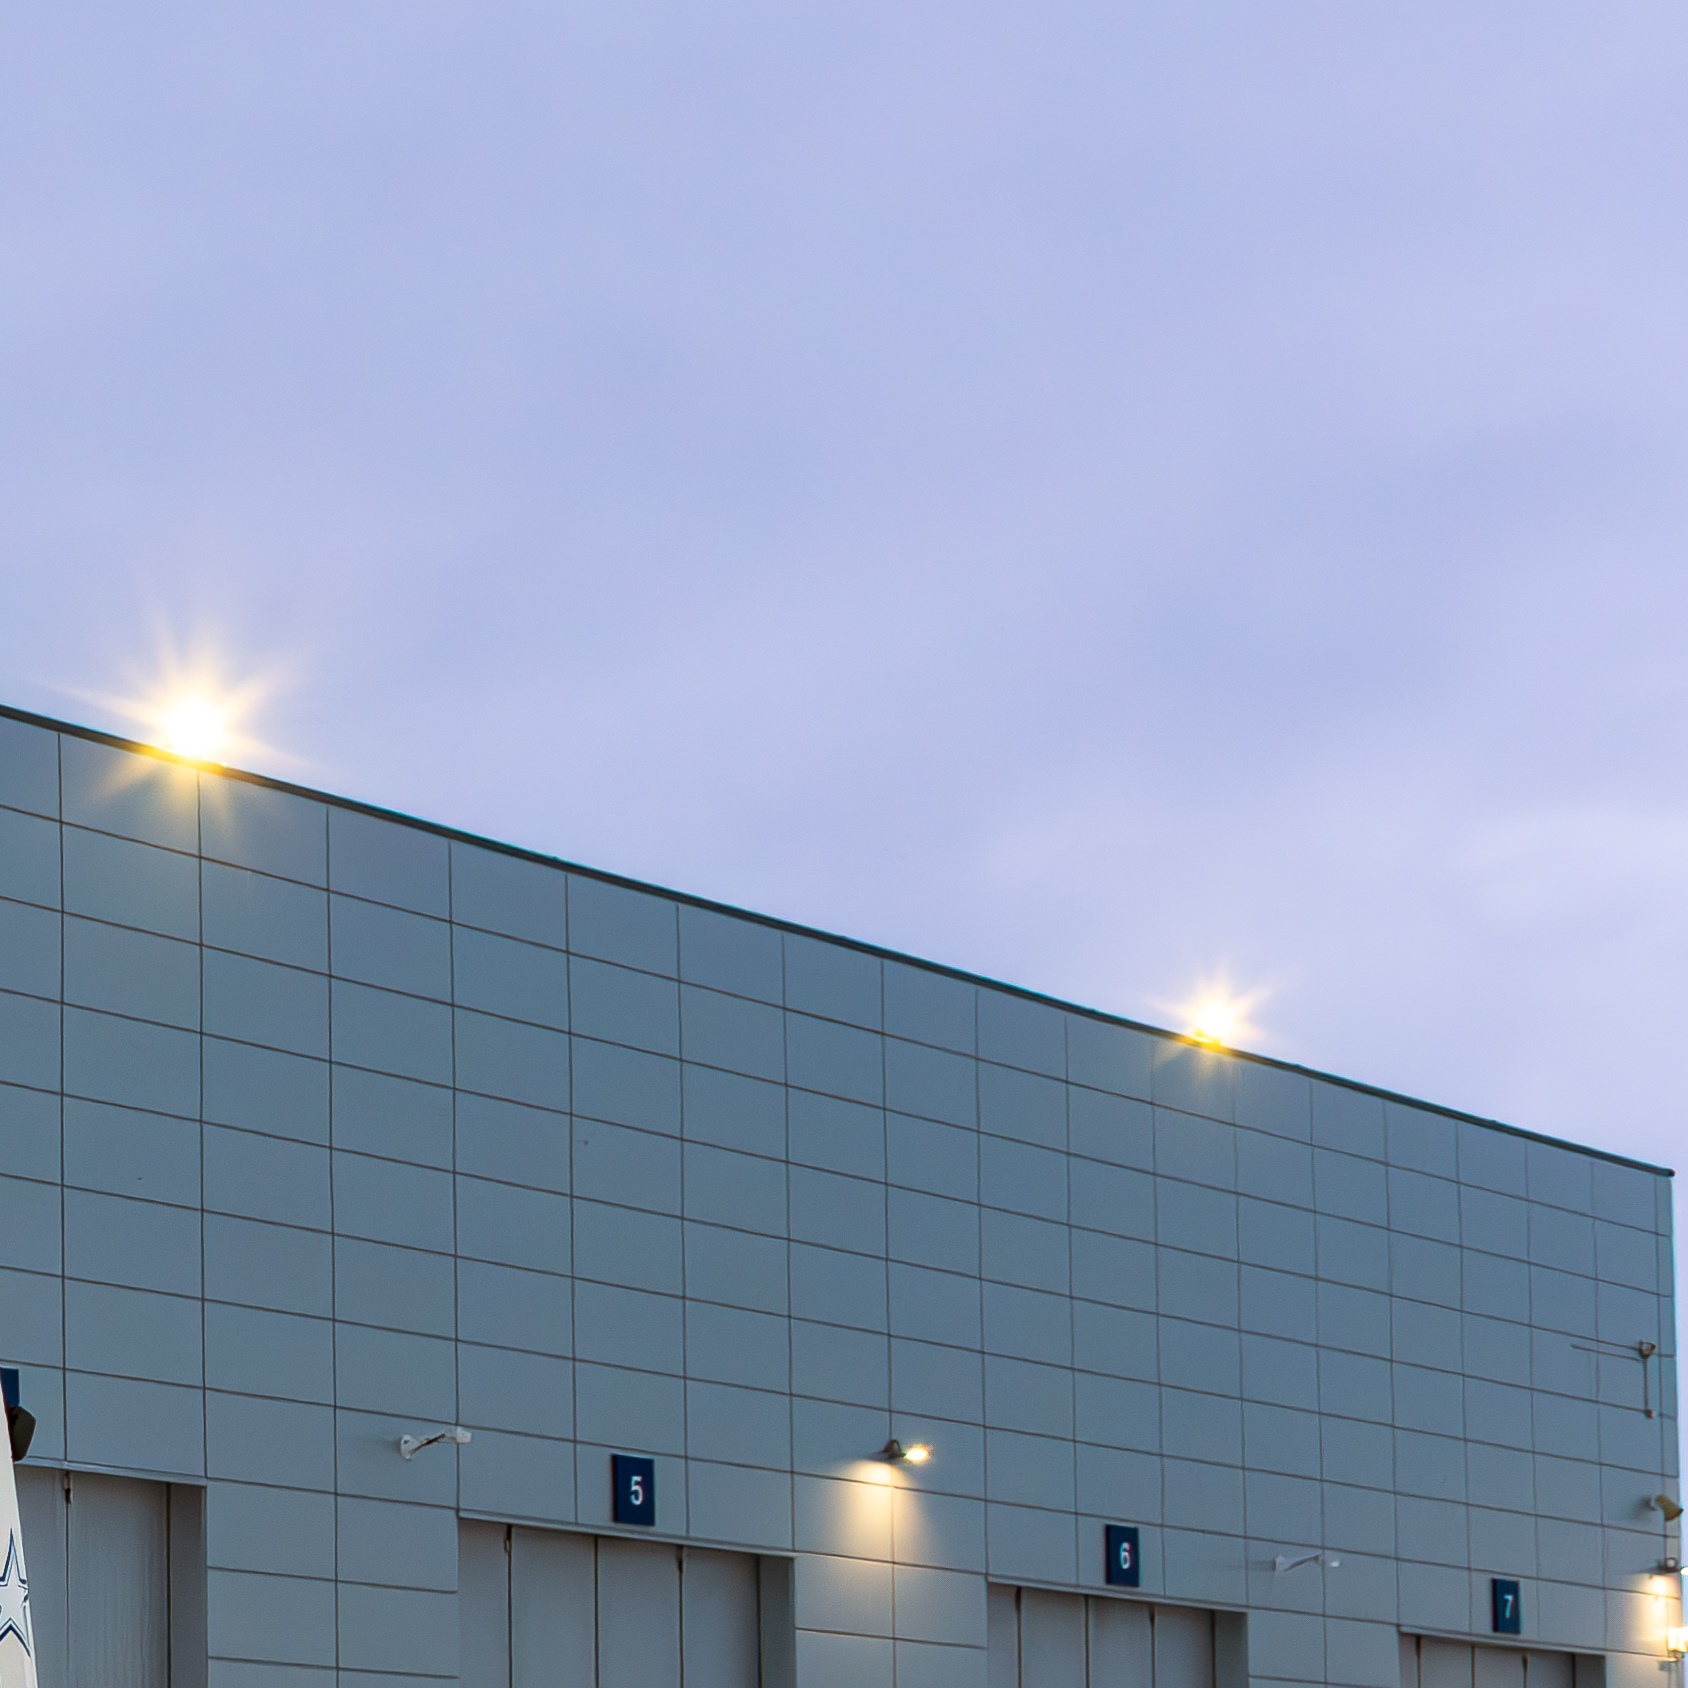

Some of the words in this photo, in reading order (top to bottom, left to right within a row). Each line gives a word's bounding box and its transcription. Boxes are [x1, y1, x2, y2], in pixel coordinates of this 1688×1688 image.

[630, 1474, 643, 1505] 5
[1119, 1541, 1131, 1569] 6
[1504, 1593, 1514, 1618] 7
